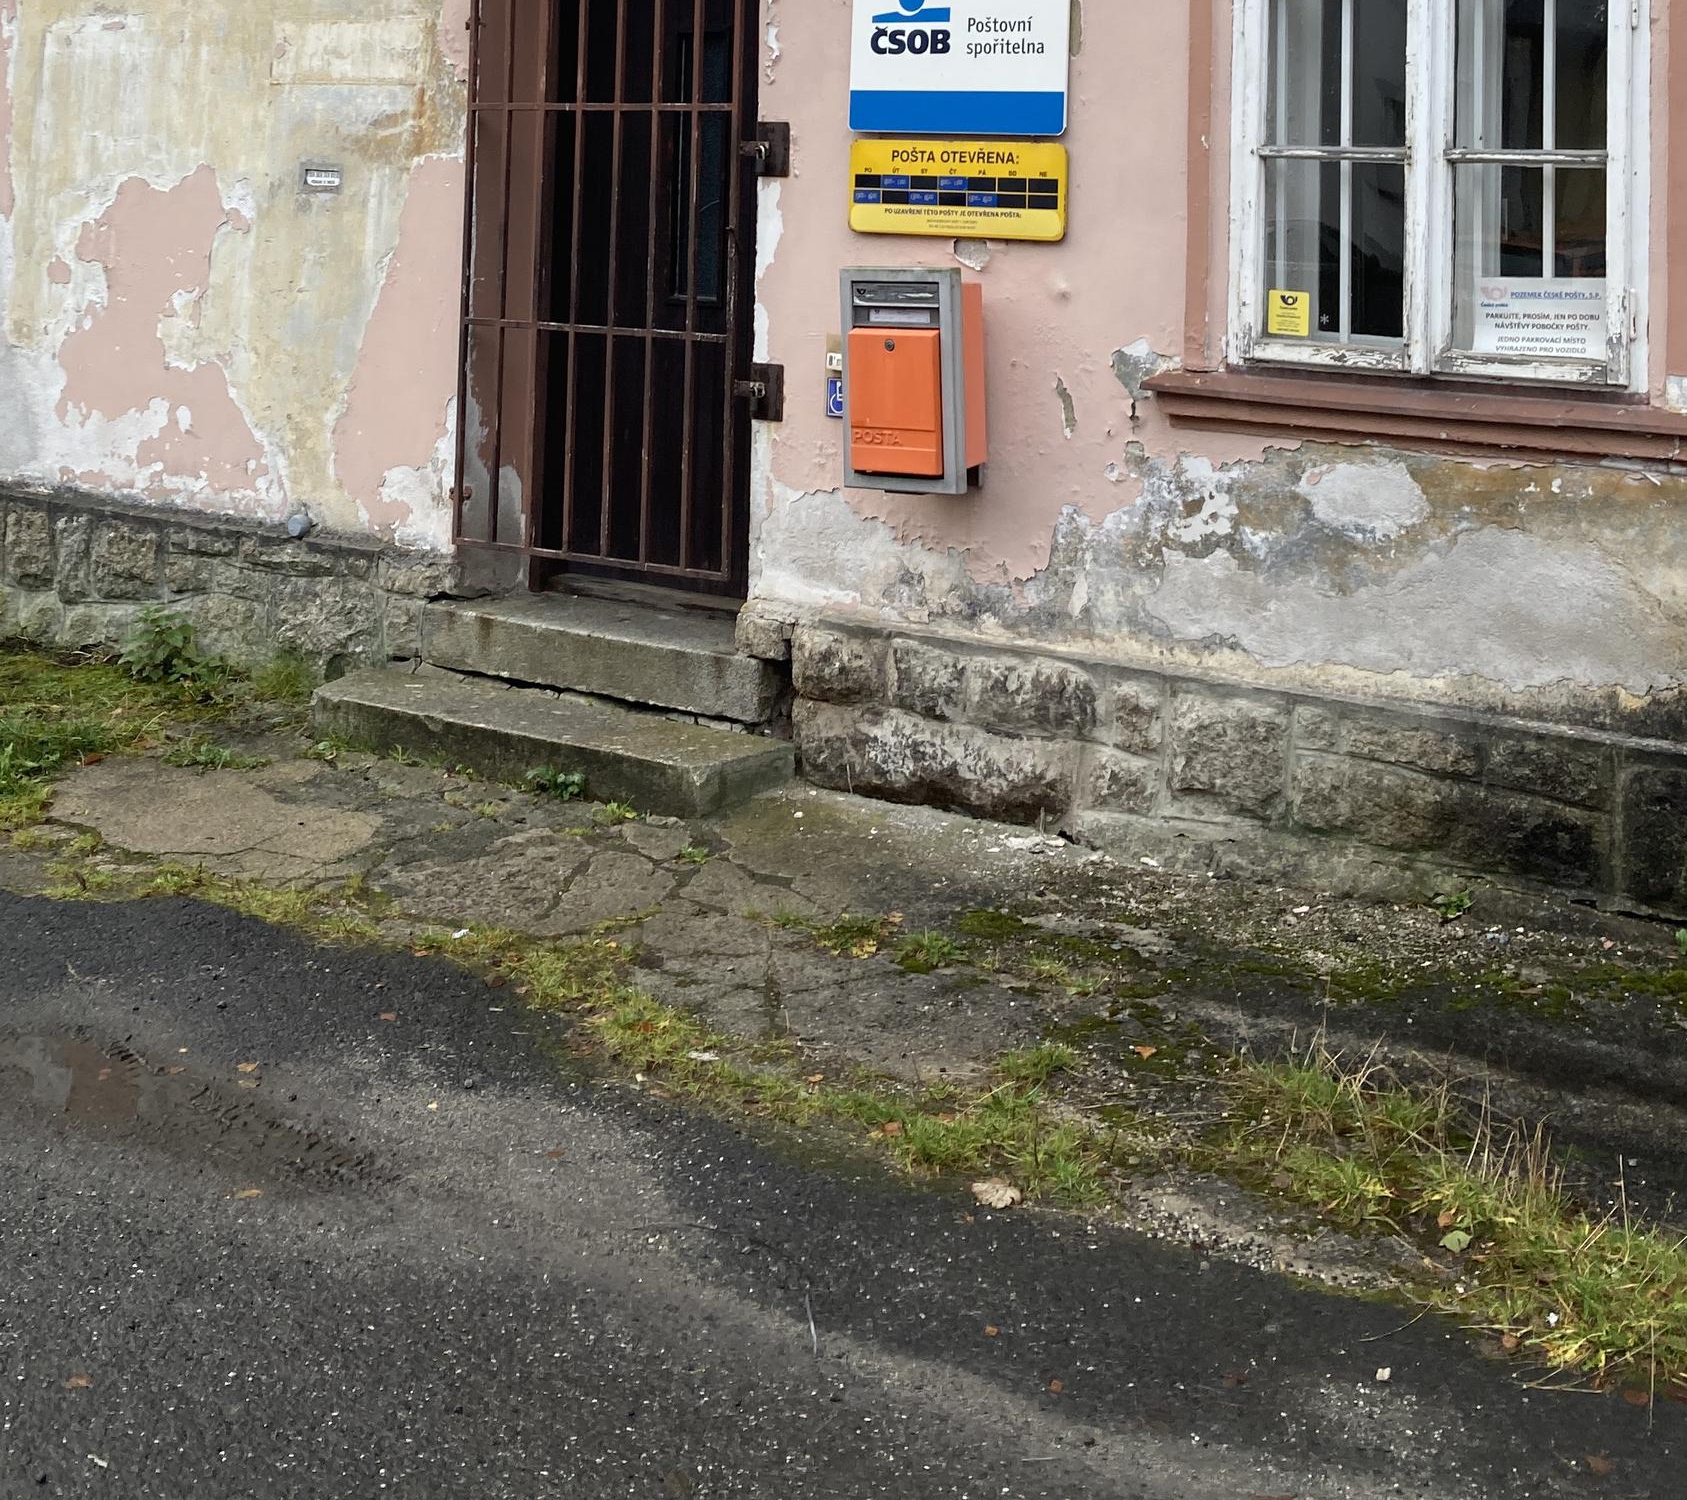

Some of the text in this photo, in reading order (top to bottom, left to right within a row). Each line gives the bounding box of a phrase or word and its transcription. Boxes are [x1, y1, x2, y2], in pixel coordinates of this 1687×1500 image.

[967, 16, 1033, 33] Poštovní
[870, 26, 951, 55] ČSOB
[966, 38, 1045, 58] spořitelna
[891, 147, 1020, 165] POŠTA OTEVŘENA:
[894, 207, 922, 215] UZAVŘENÍ
[939, 208, 958, 216] POŠTY
[967, 210, 999, 218] OTEVŘENA
[1000, 211, 1022, 219] POŠTA:
[1544, 290, 1563, 299] ČESKÉ
[1565, 291, 1587, 300] POŠTY,
[1589, 292, 1601, 300] S.P.
[1486, 312, 1521, 320] PARKUJTE,
[1523, 312, 1552, 320] PROSÍM,
[1495, 321, 1590, 331] NÁVŠTĚVY POBOČKY POŠTY.
[1563, 336, 1586, 345] MÍSTO
